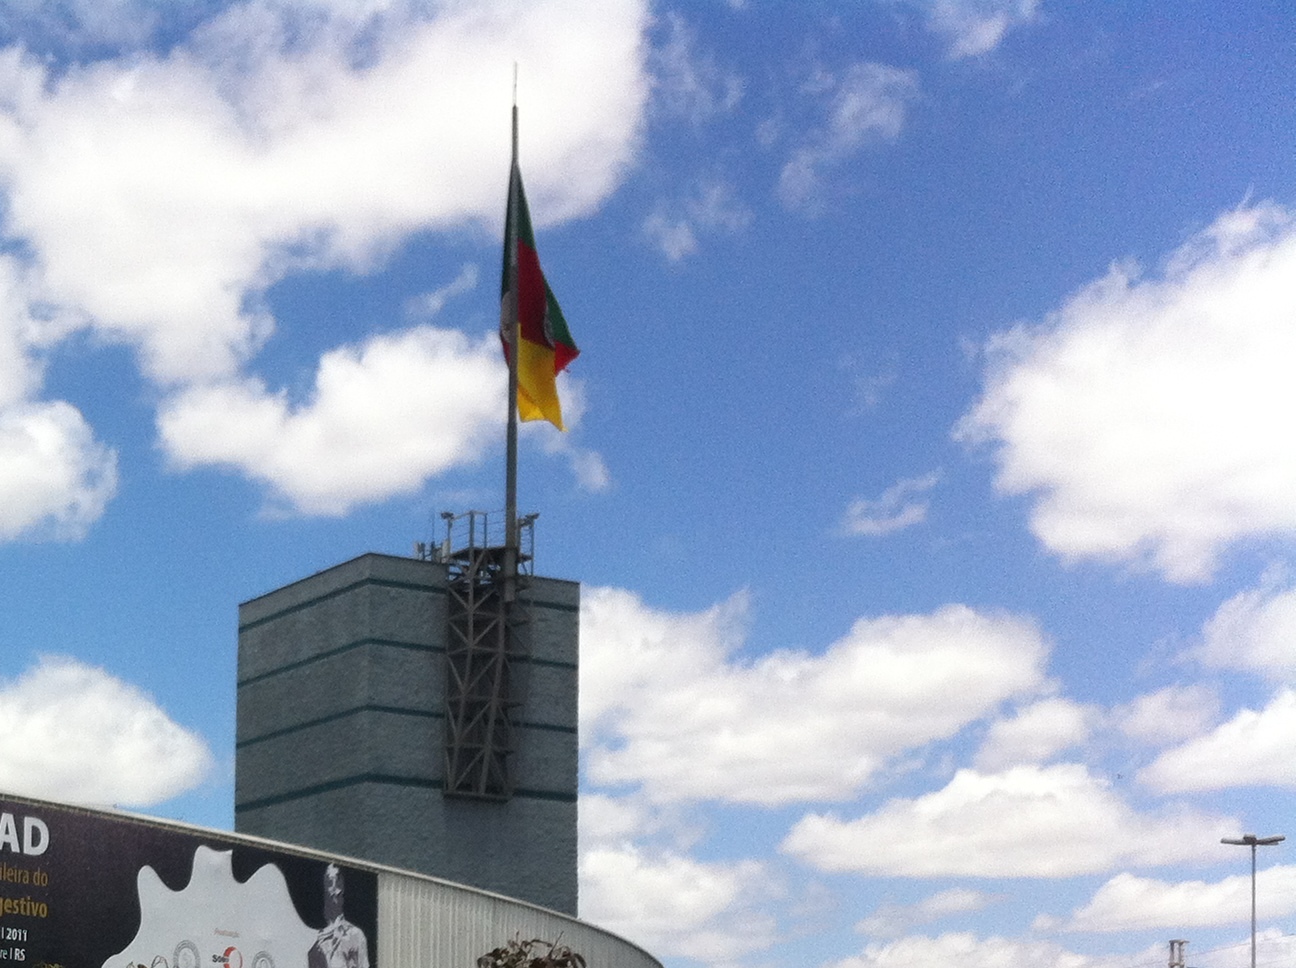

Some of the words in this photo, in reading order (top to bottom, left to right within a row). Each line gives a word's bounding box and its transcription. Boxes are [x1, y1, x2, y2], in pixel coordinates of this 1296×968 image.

[33, 866, 49, 887] do
[6, 927, 28, 942] 2011
[14, 948, 26, 962] RS
